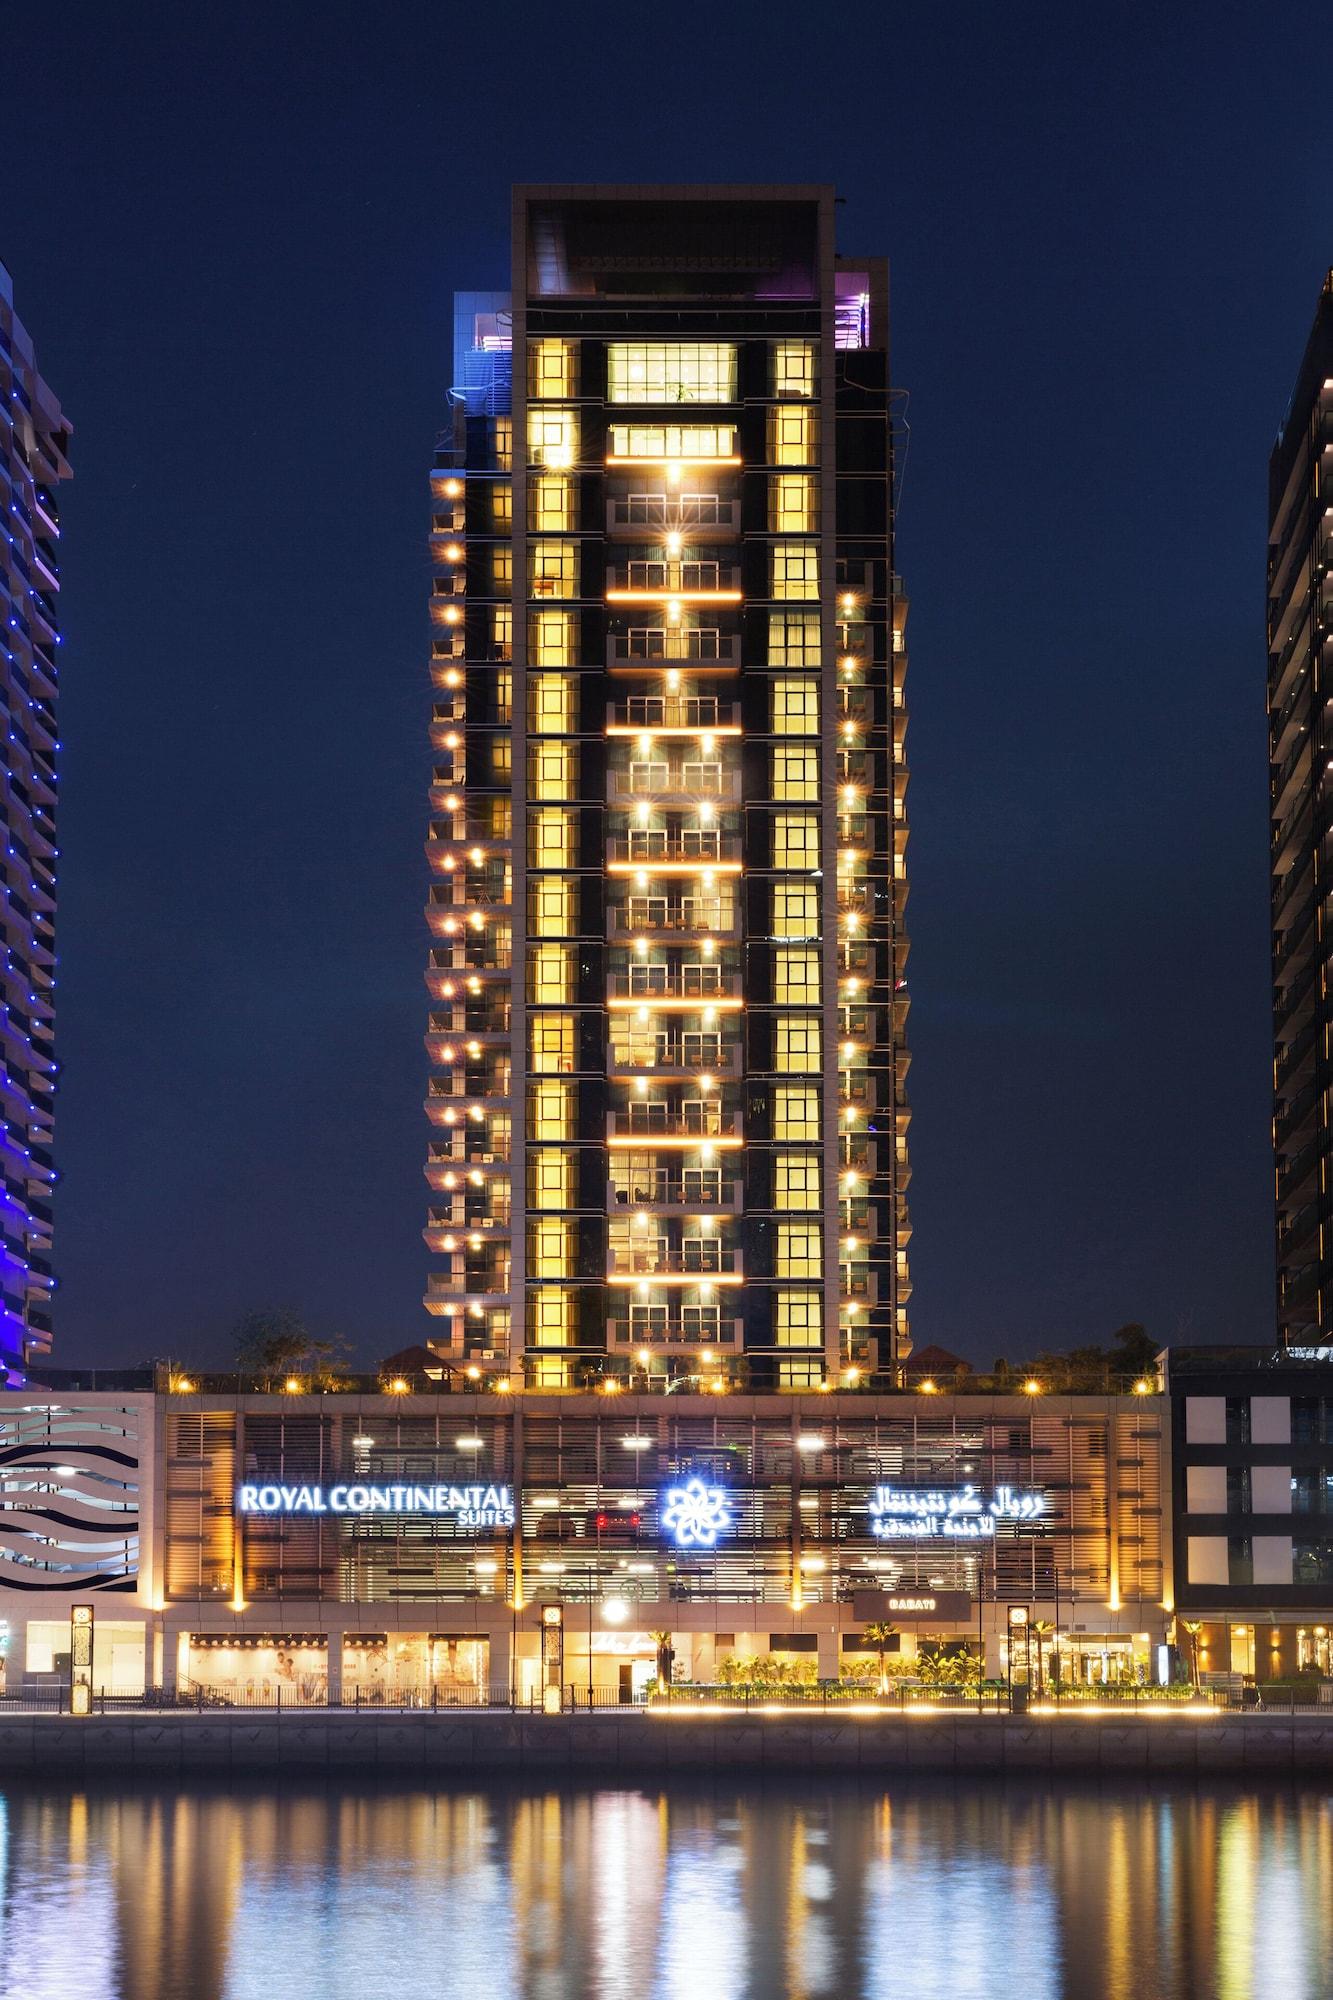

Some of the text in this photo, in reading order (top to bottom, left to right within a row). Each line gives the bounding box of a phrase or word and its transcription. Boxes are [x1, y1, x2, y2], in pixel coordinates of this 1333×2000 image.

[240, 1485, 514, 1511] ROYAL CONTINENTAL
[991, 1487, 1045, 1517] رويال
[458, 1509, 515, 1525] SUITES
